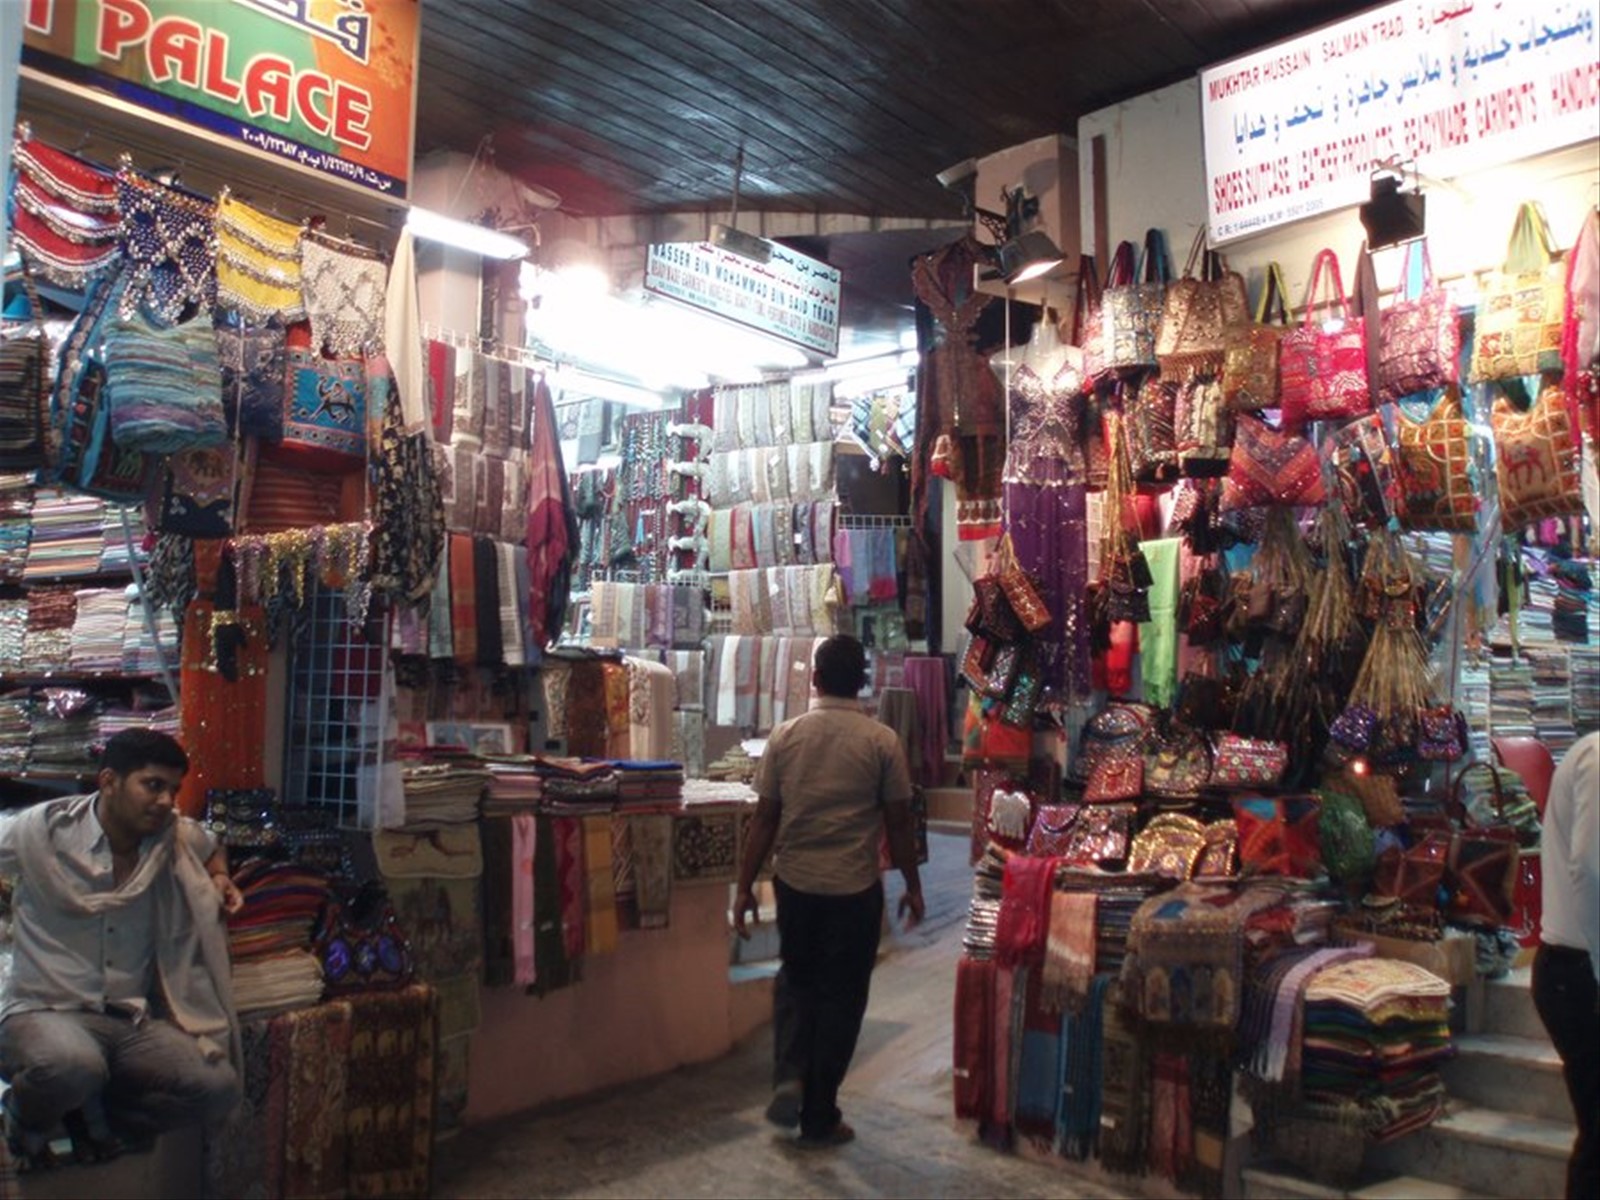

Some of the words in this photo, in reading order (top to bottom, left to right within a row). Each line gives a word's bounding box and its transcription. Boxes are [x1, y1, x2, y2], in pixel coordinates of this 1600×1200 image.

[97, 0, 373, 150] PALACE
[1208, 66, 1260, 102] MUKHTAR
[1262, 49, 1312, 82] HUSSAIN
[1321, 30, 1369, 63] SALMAN
[1214, 170, 1244, 214] SHOES
[1550, 60, 1600, 118] HANDIC
[695, 256, 710, 276] BIN
[715, 265, 768, 298] MOHAMMAD
[771, 287, 785, 305] BIN
[789, 294, 808, 315] SAID
